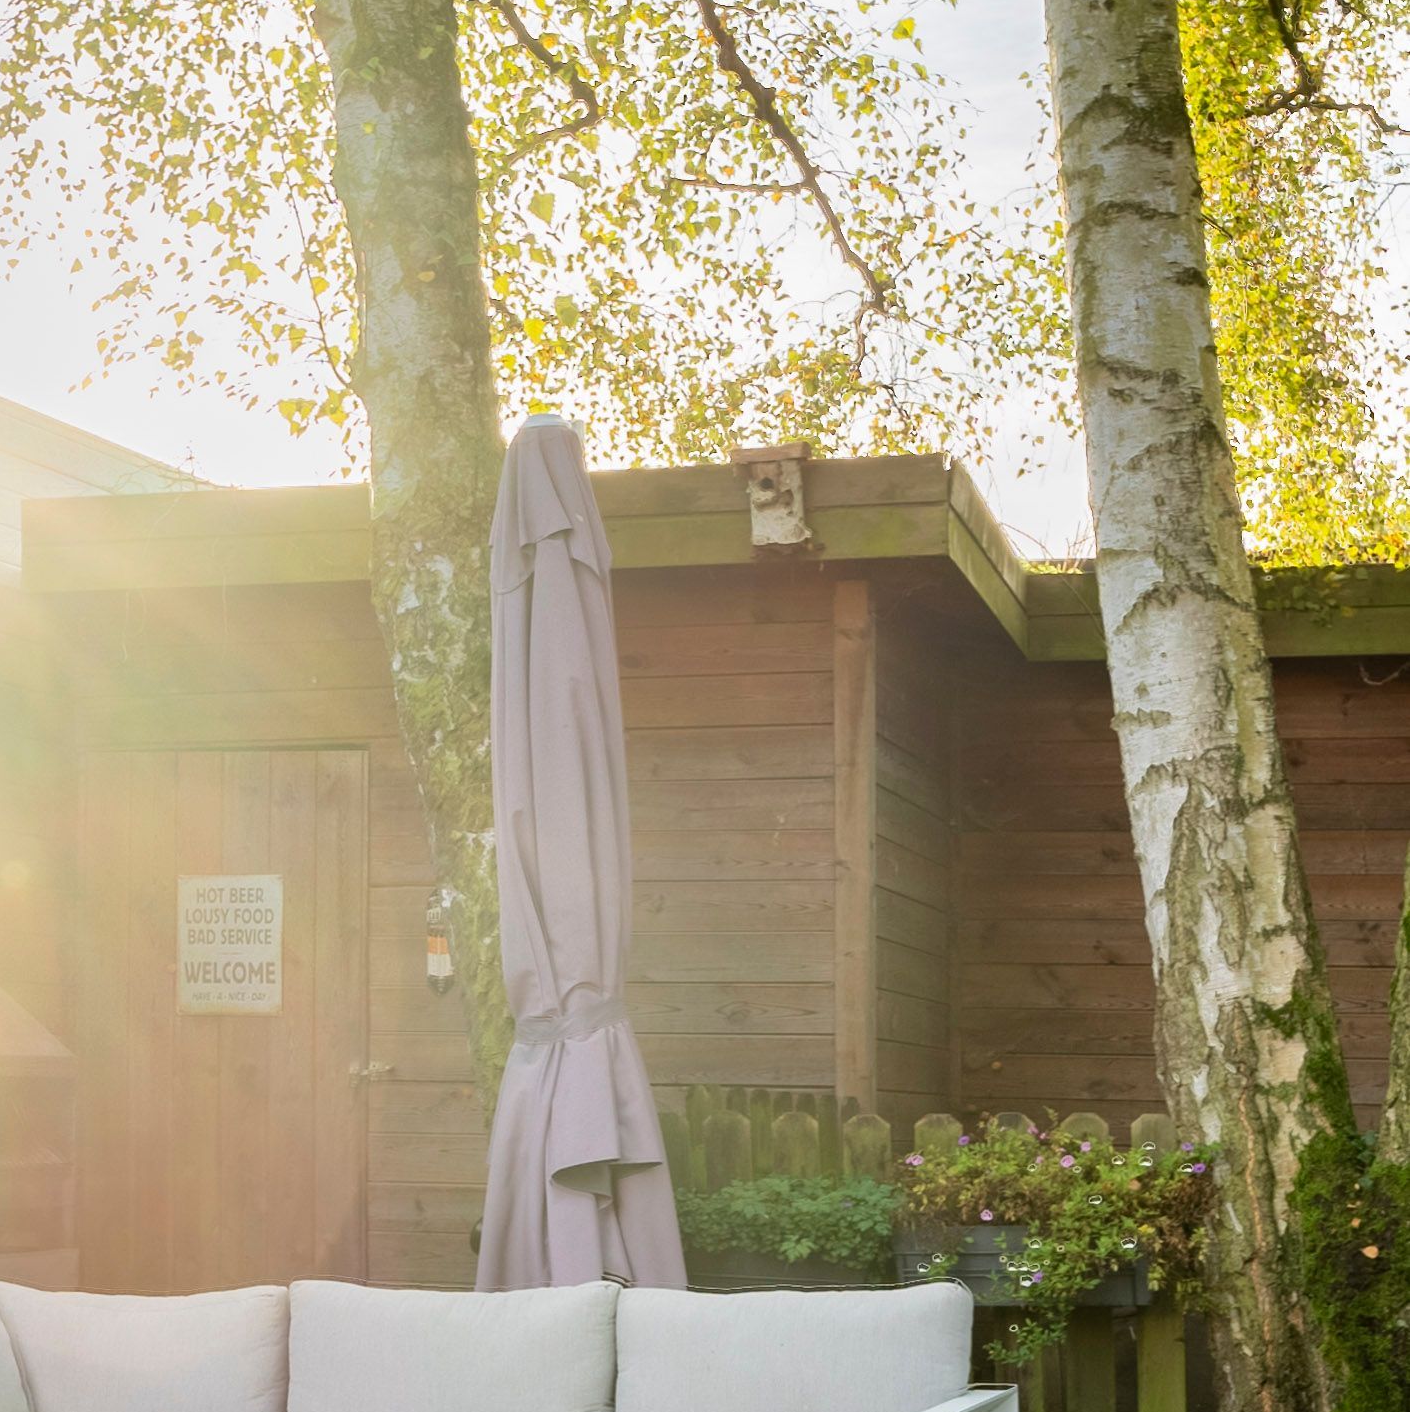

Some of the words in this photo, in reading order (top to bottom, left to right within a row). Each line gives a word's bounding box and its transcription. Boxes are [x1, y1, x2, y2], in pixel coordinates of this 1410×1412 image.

[196, 887, 225, 904] HOT
[229, 887, 264, 904] BEER
[185, 908, 230, 924] LOUSY
[234, 908, 275, 924] FOOD
[188, 929, 216, 945] BAD
[220, 929, 272, 945] SERVICE
[184, 961, 276, 984] WELCOME
[251, 992, 266, 1001] DAY
